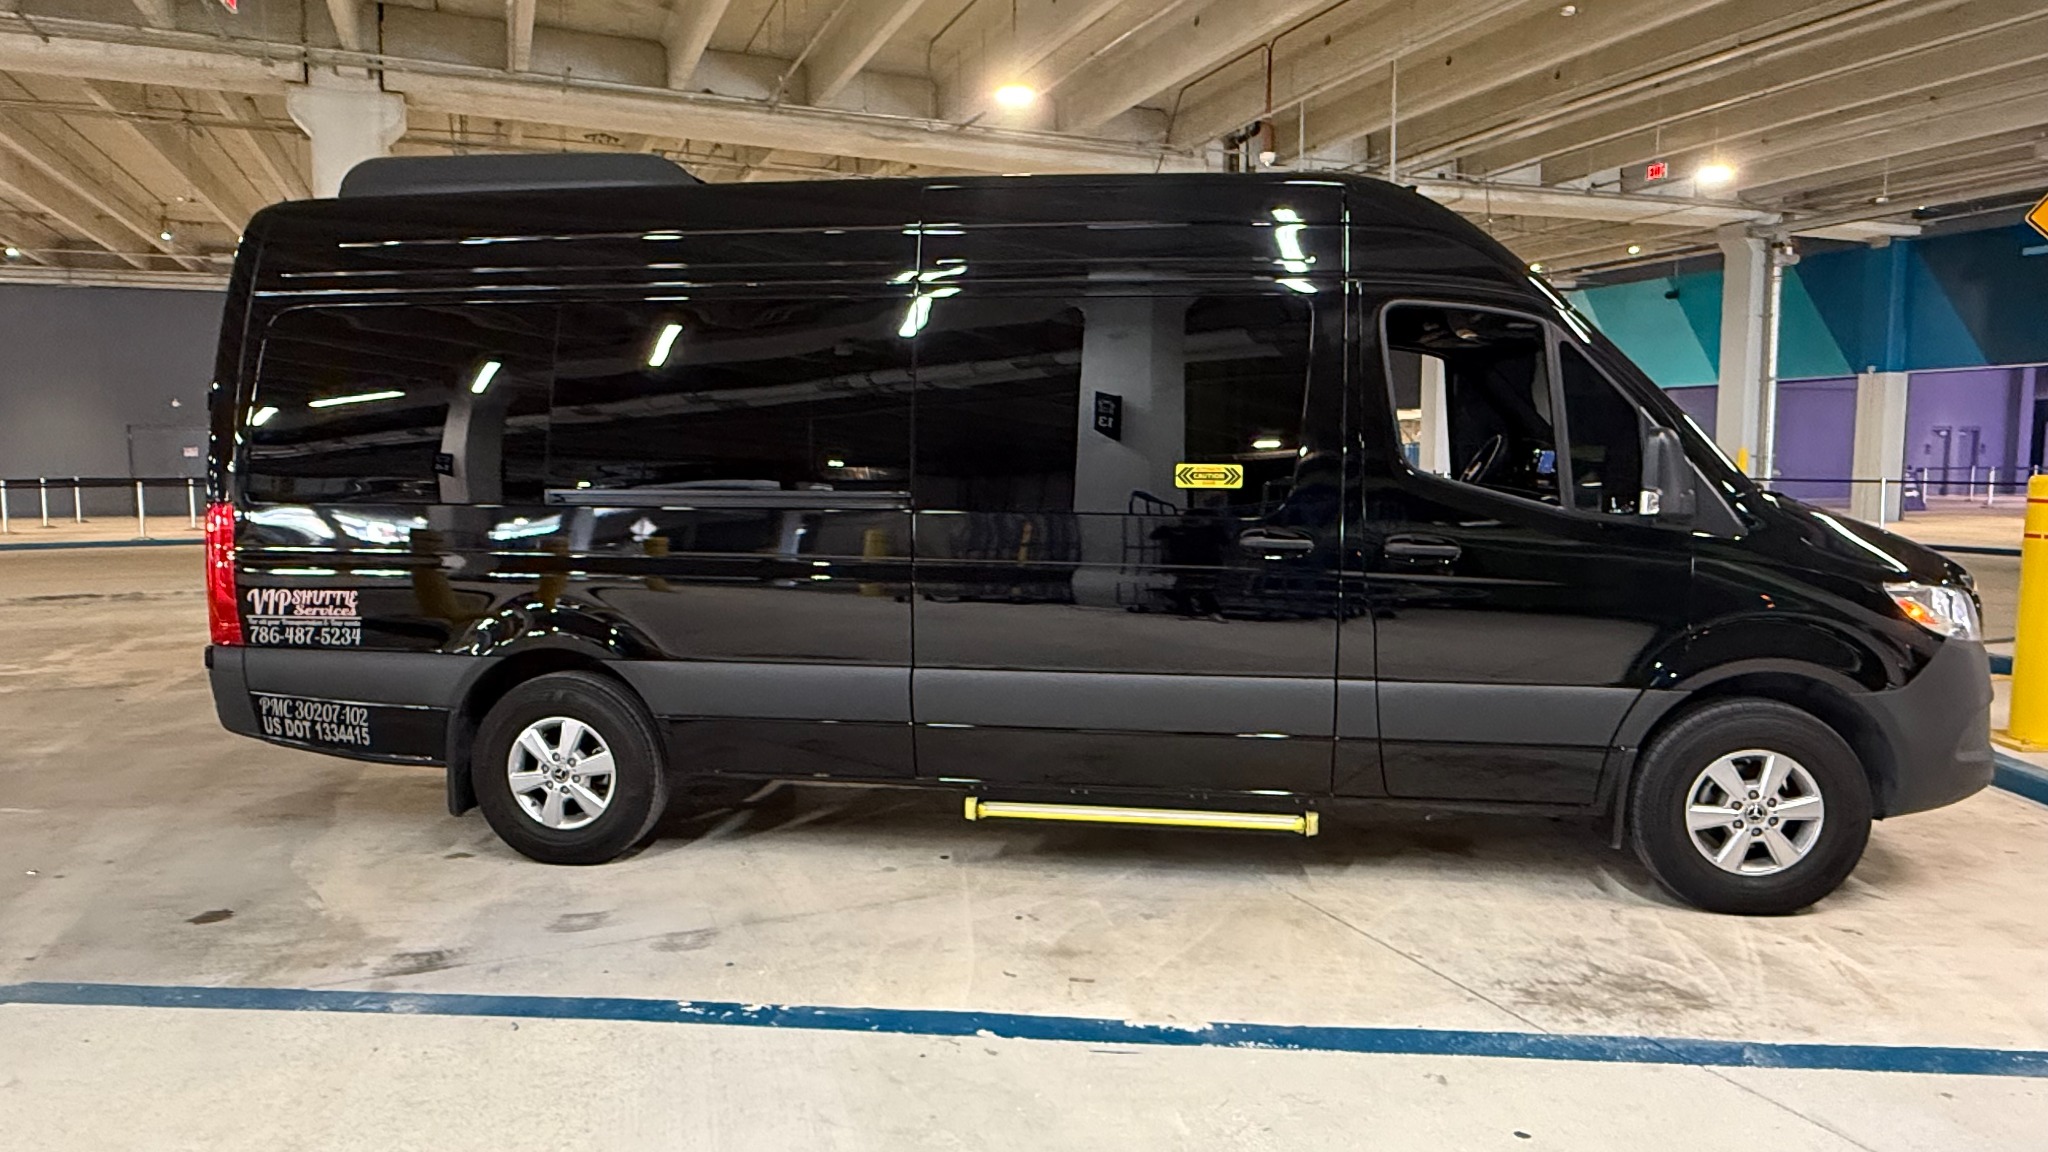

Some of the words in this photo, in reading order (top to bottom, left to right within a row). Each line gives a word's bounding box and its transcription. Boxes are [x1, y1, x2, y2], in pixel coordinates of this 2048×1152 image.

[246, 588, 292, 615] VIP
[291, 589, 358, 607] SHUTTLE
[293, 604, 357, 616] Services
[250, 626, 361, 645] 786-487-5234
[259, 697, 293, 716] PMC
[295, 701, 368, 726] 30207-102
[263, 716, 282, 735] US
[284, 719, 311, 739] DOT
[315, 723, 371, 746] 1334415
